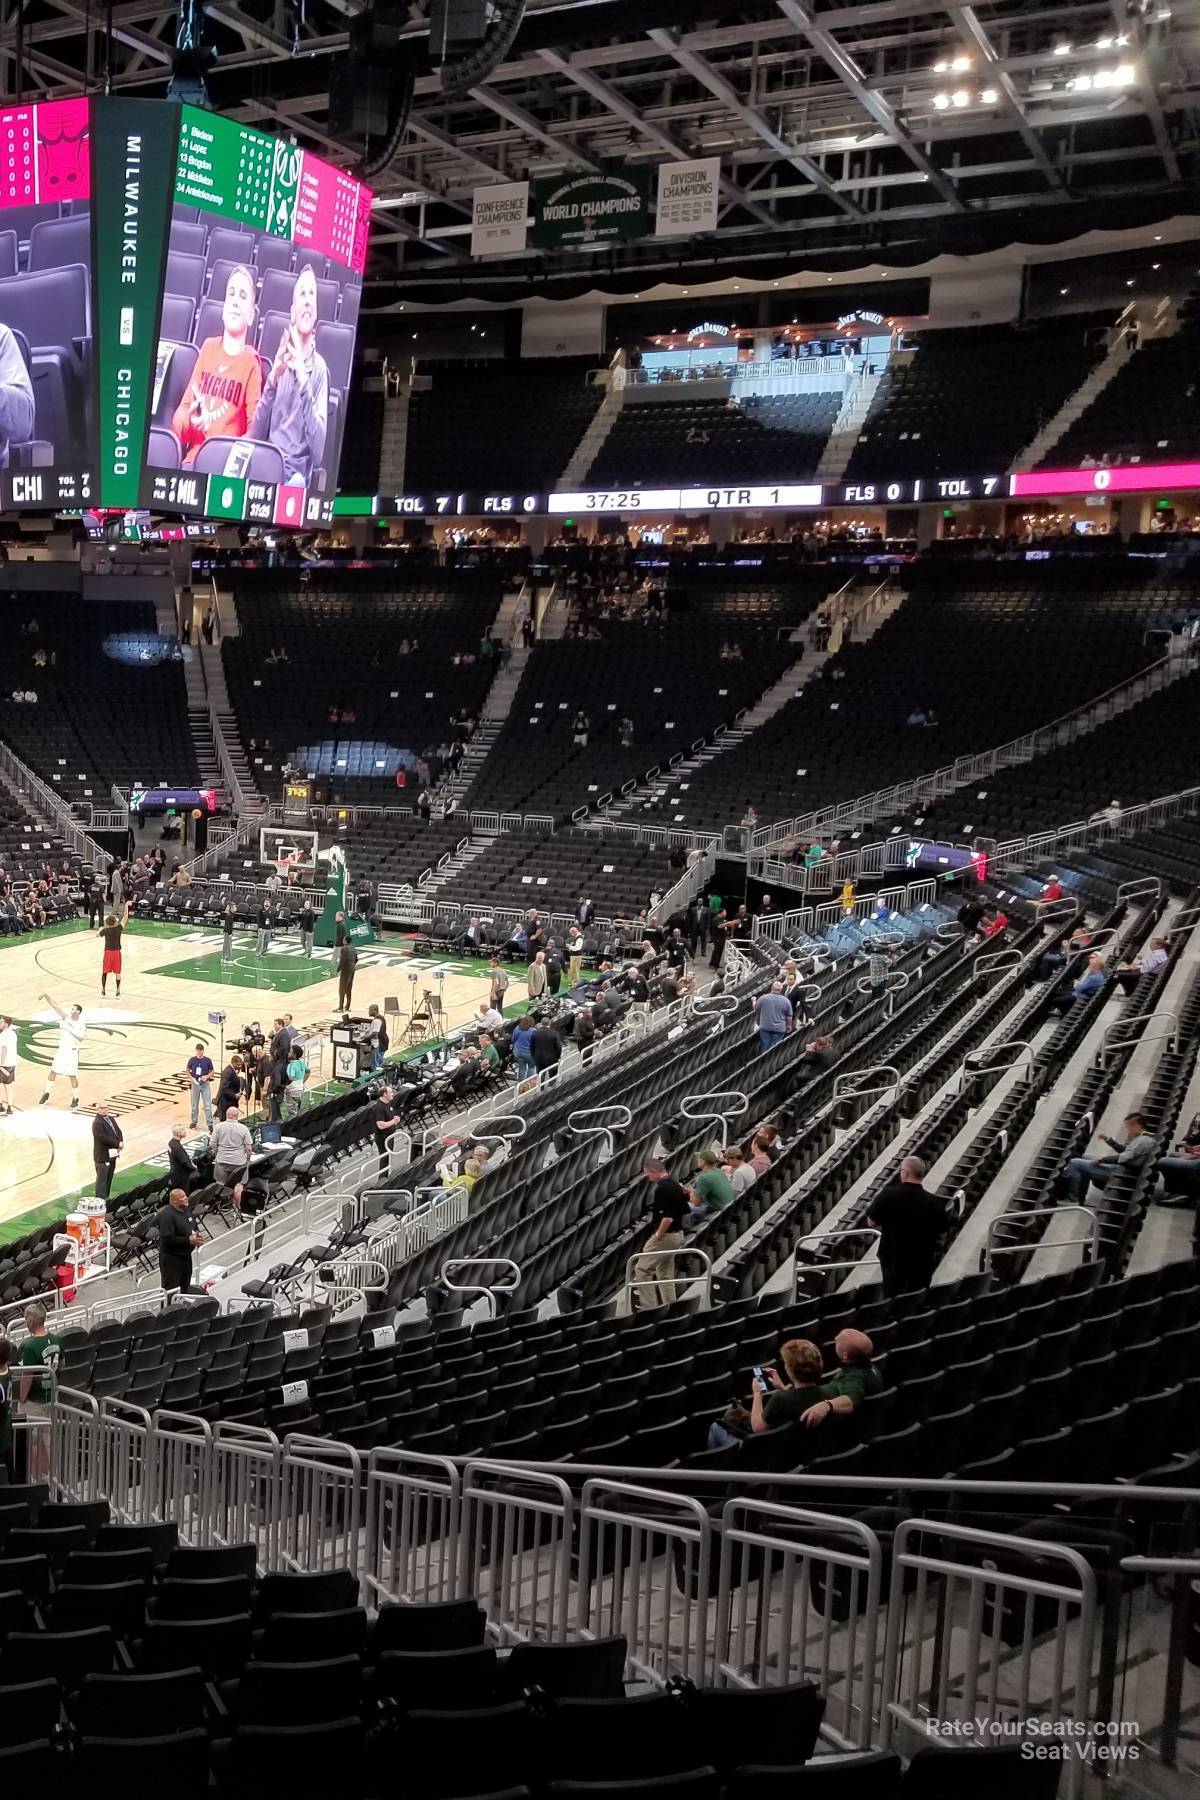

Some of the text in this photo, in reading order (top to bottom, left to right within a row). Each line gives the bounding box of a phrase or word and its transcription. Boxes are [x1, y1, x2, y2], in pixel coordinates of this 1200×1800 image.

[8, 129, 14, 138] 0
[23, 127, 29, 137] 0
[8, 143, 14, 153] 0
[24, 141, 29, 151] 0
[181, 138, 188, 147] 11
[9, 158, 14, 167] 0
[24, 155, 29, 165] 0
[178, 167, 186, 177] 22
[671, 171, 707, 185] DIVISION
[663, 182, 712, 198] CHAMPIONS
[122, 136, 141, 283] MILWAUKEE
[476, 198, 524, 214] CONFERENCE
[543, 203, 578, 221] WORLD
[581, 196, 641, 217] CHAMPIONS
[478, 210, 522, 225] CHAMPIONS
[114, 369, 131, 475] CHICAGO
[59, 475, 89, 485] TOL 7
[170, 478, 177, 489] 7
[1094, 471, 1108, 489] 0
[12, 477, 42, 501] CHI
[82, 488, 90, 498] 0
[177, 478, 198, 506] MIL
[266, 488, 273, 500] 1
[845, 478, 994, 502] FLS 0 TOL 7
[221, 487, 233, 508] 0
[394, 496, 535, 514] TOL 7 FLS 0
[585, 492, 641, 508] 37:25
[707, 489, 782, 508] QTR 1
[250, 503, 270, 518] 37:25
[286, 497, 295, 517] 0
